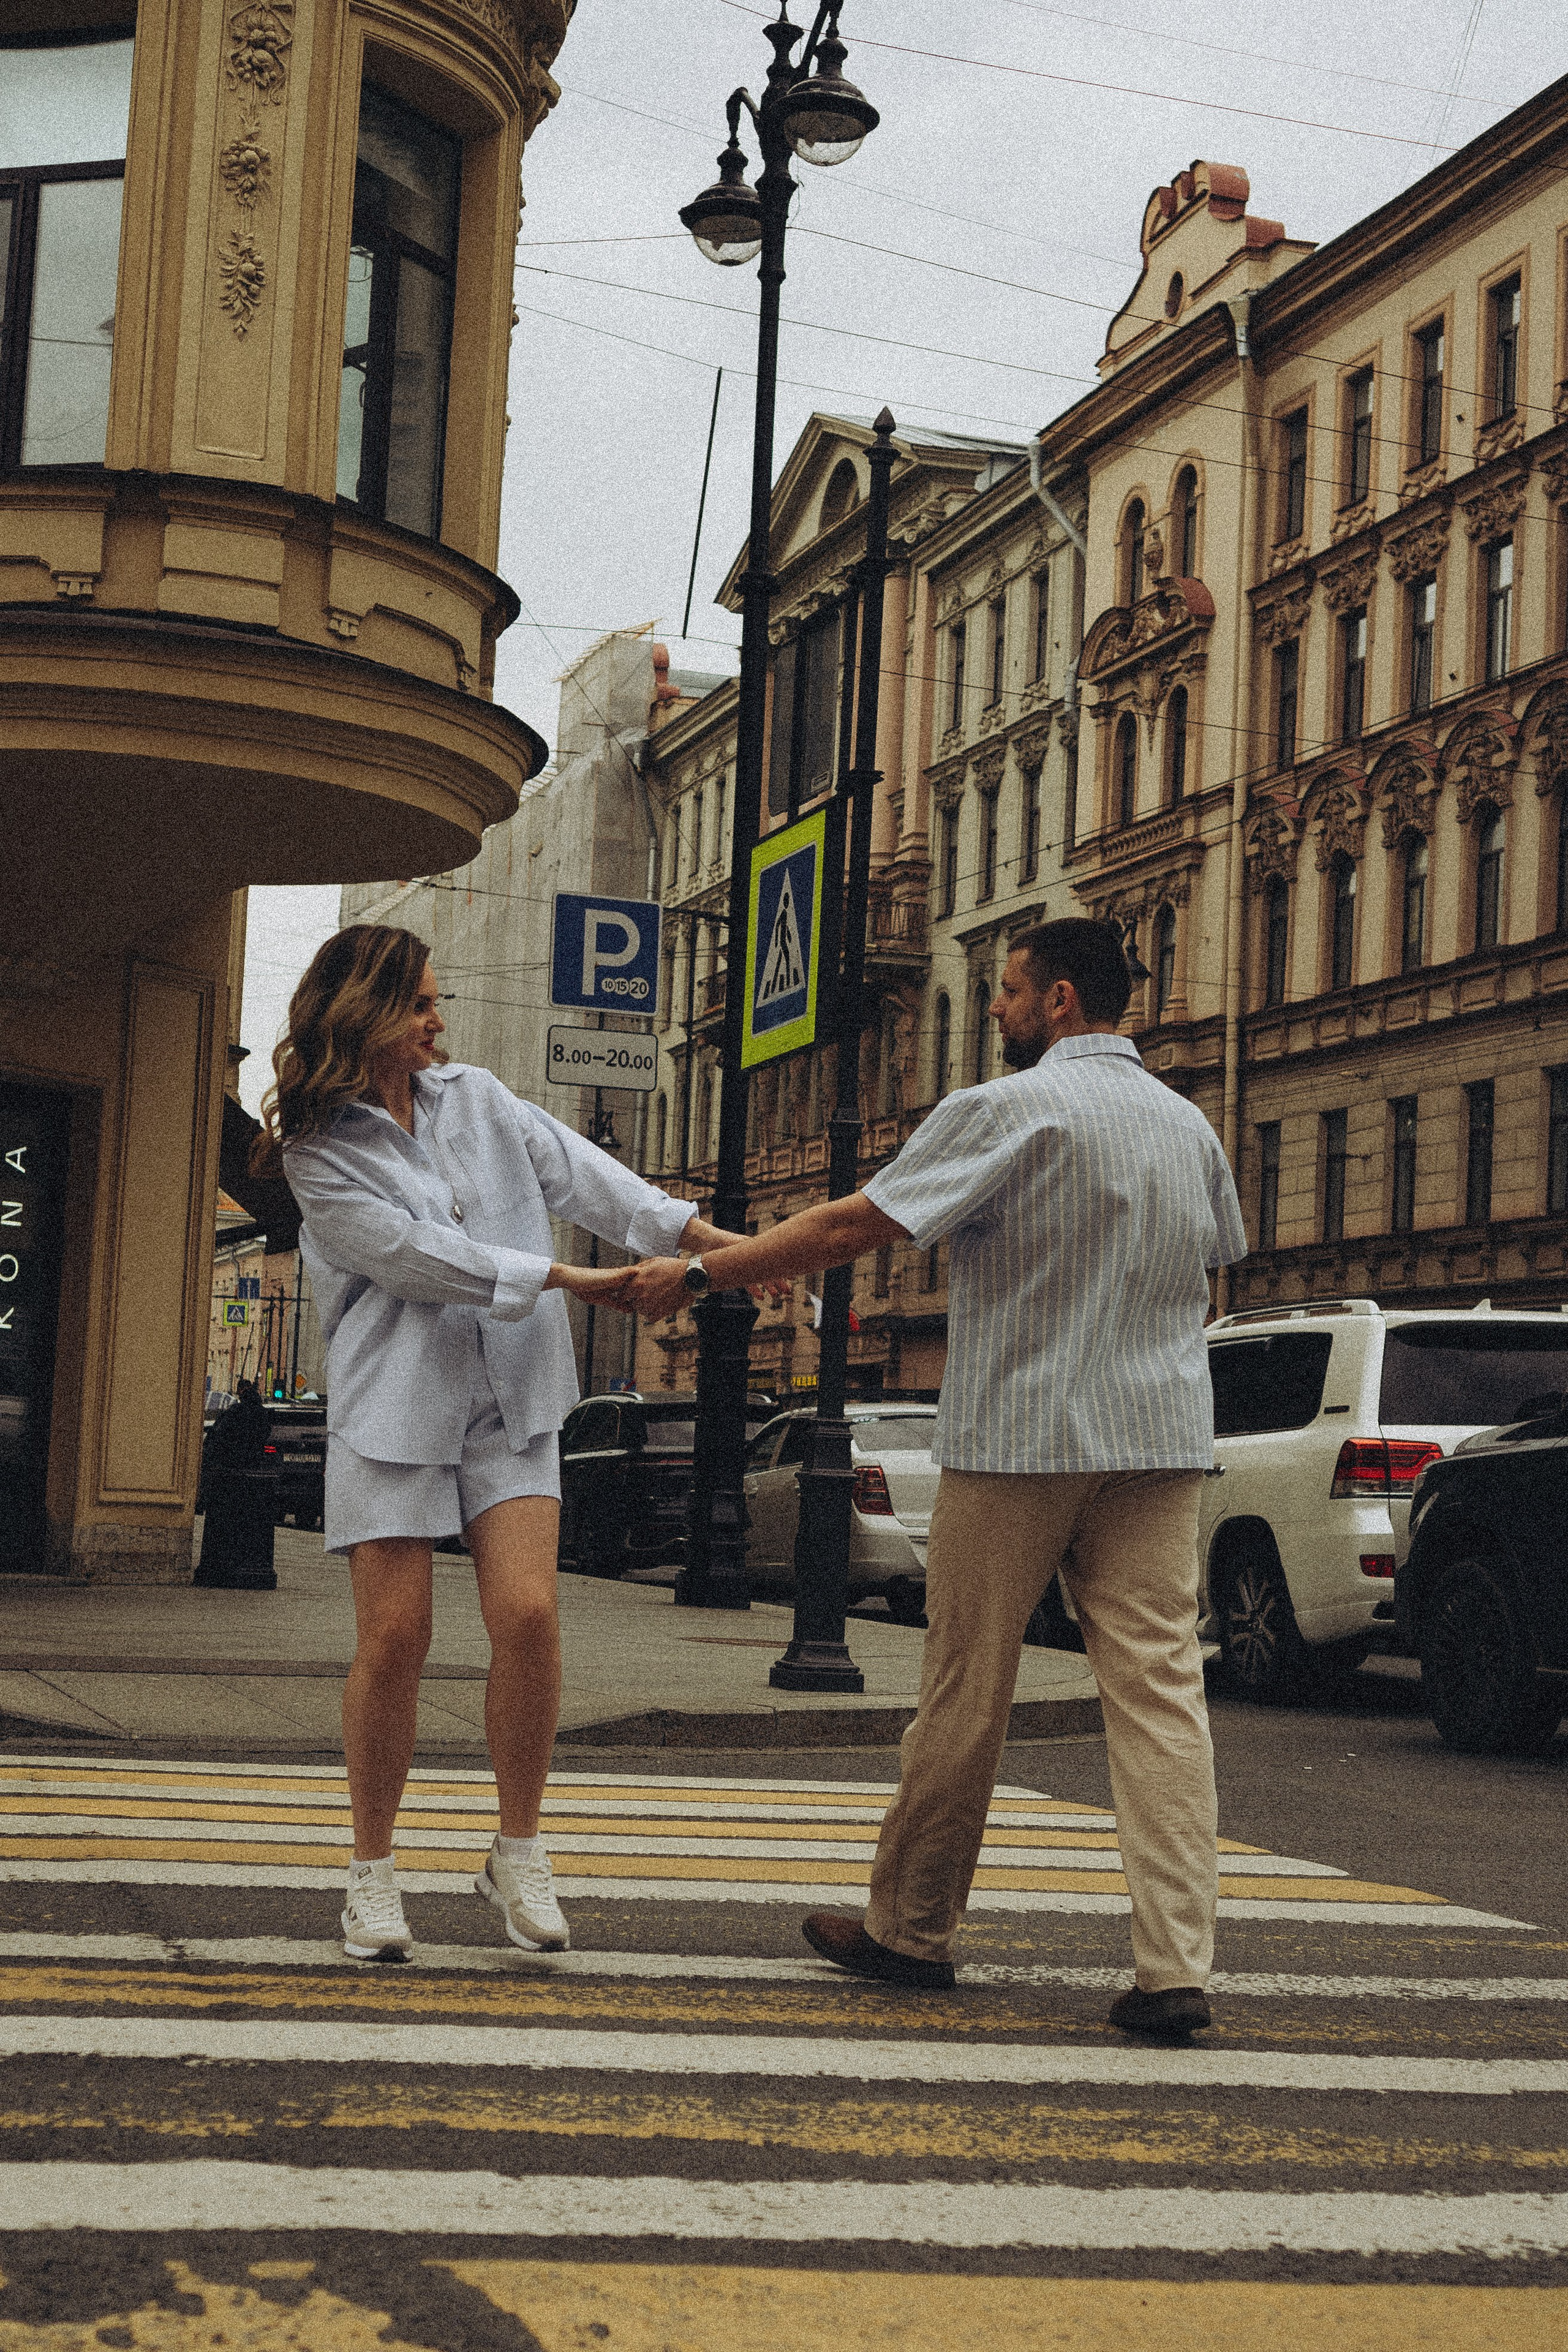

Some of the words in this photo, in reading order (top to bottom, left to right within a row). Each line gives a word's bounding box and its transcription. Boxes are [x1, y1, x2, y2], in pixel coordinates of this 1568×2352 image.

[582, 908, 640, 996] P
[605, 981, 613, 989] 10
[616, 981, 627, 992] 15
[630, 981, 647, 995] 20
